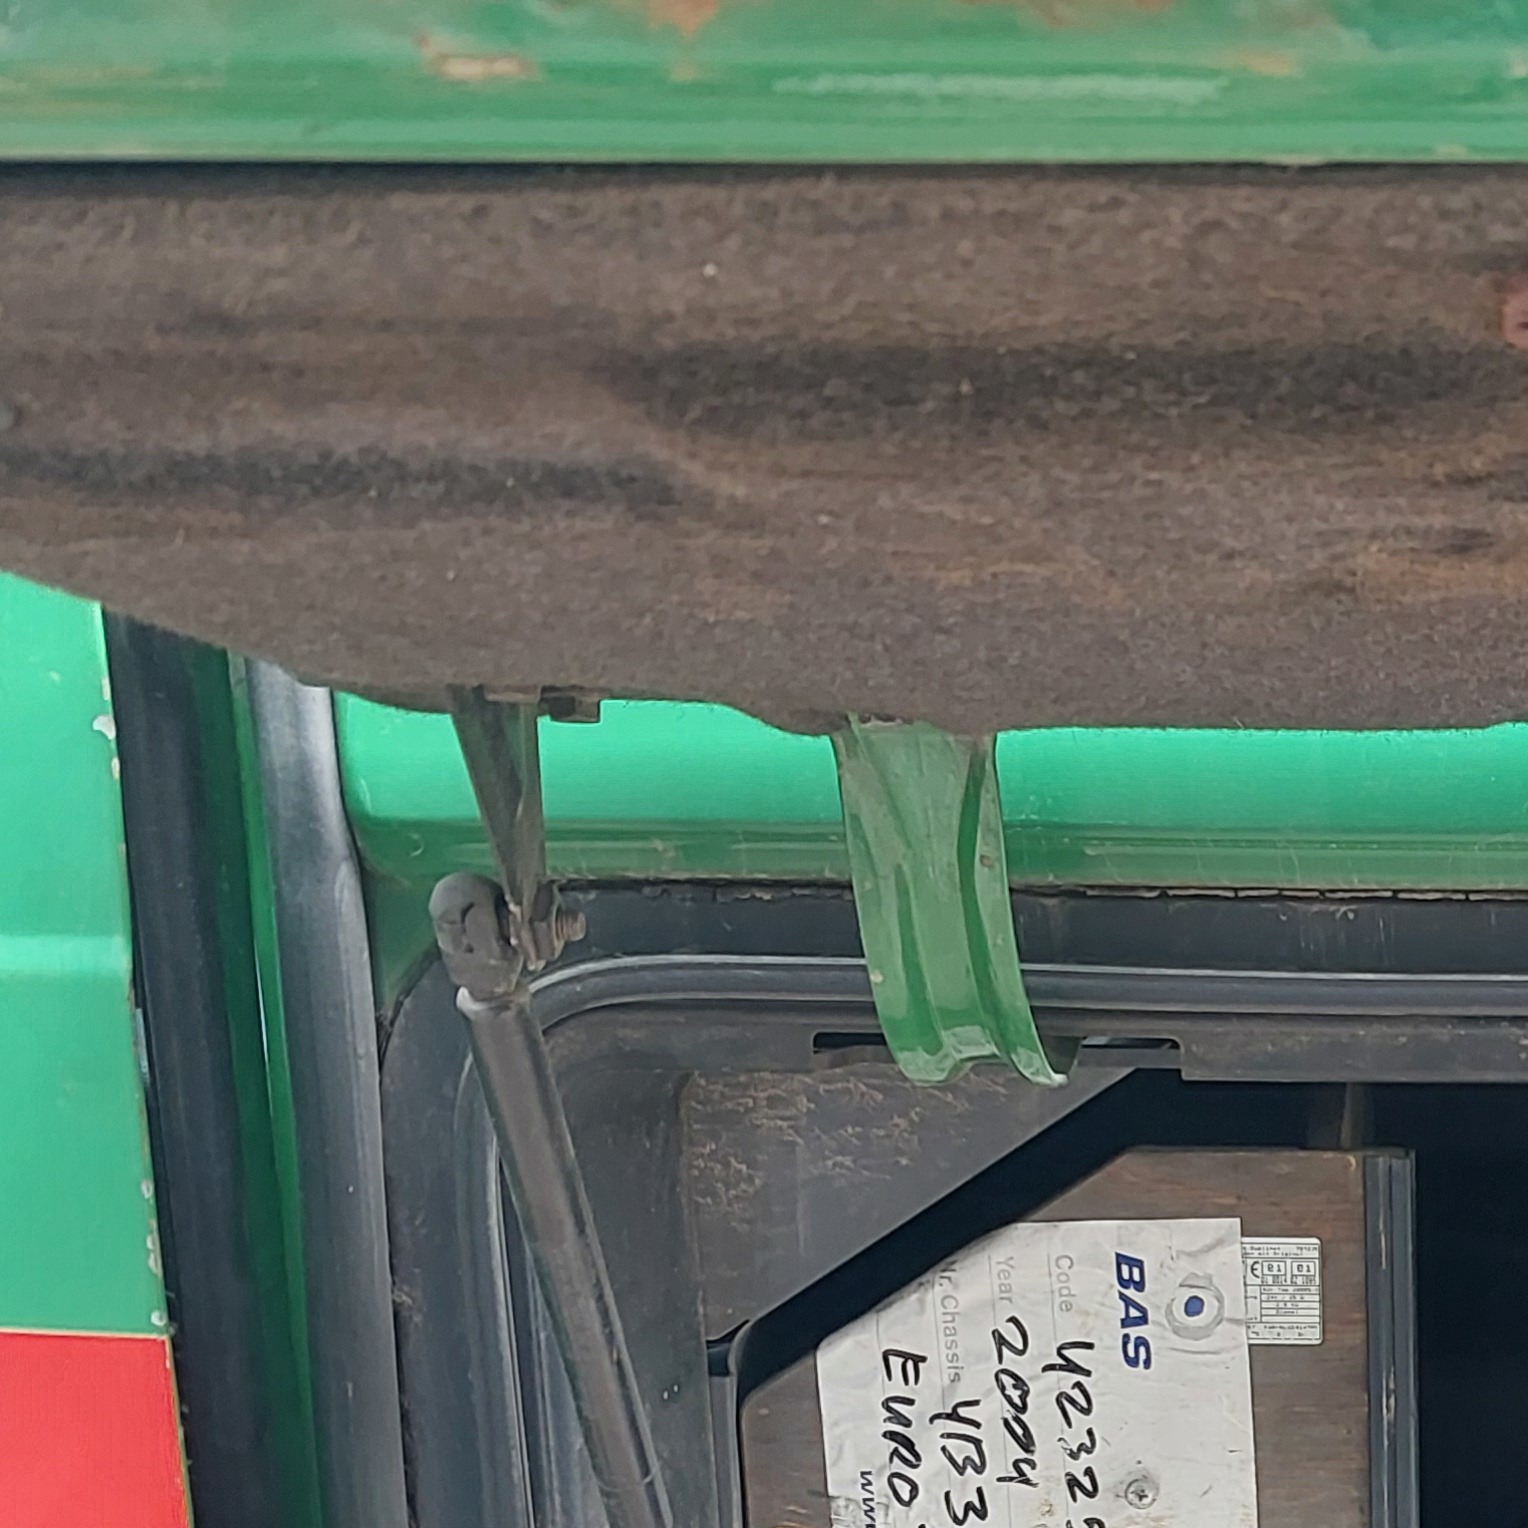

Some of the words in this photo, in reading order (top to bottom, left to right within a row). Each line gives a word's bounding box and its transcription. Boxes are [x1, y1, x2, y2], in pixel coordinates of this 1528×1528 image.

[997, 1256, 1015, 1304] Year
[1055, 1254, 1077, 1313] Code
[1114, 1251, 1154, 1371] BAS
[940, 1295, 964, 1384] Chassis
[881, 1348, 928, 1508] EURO
